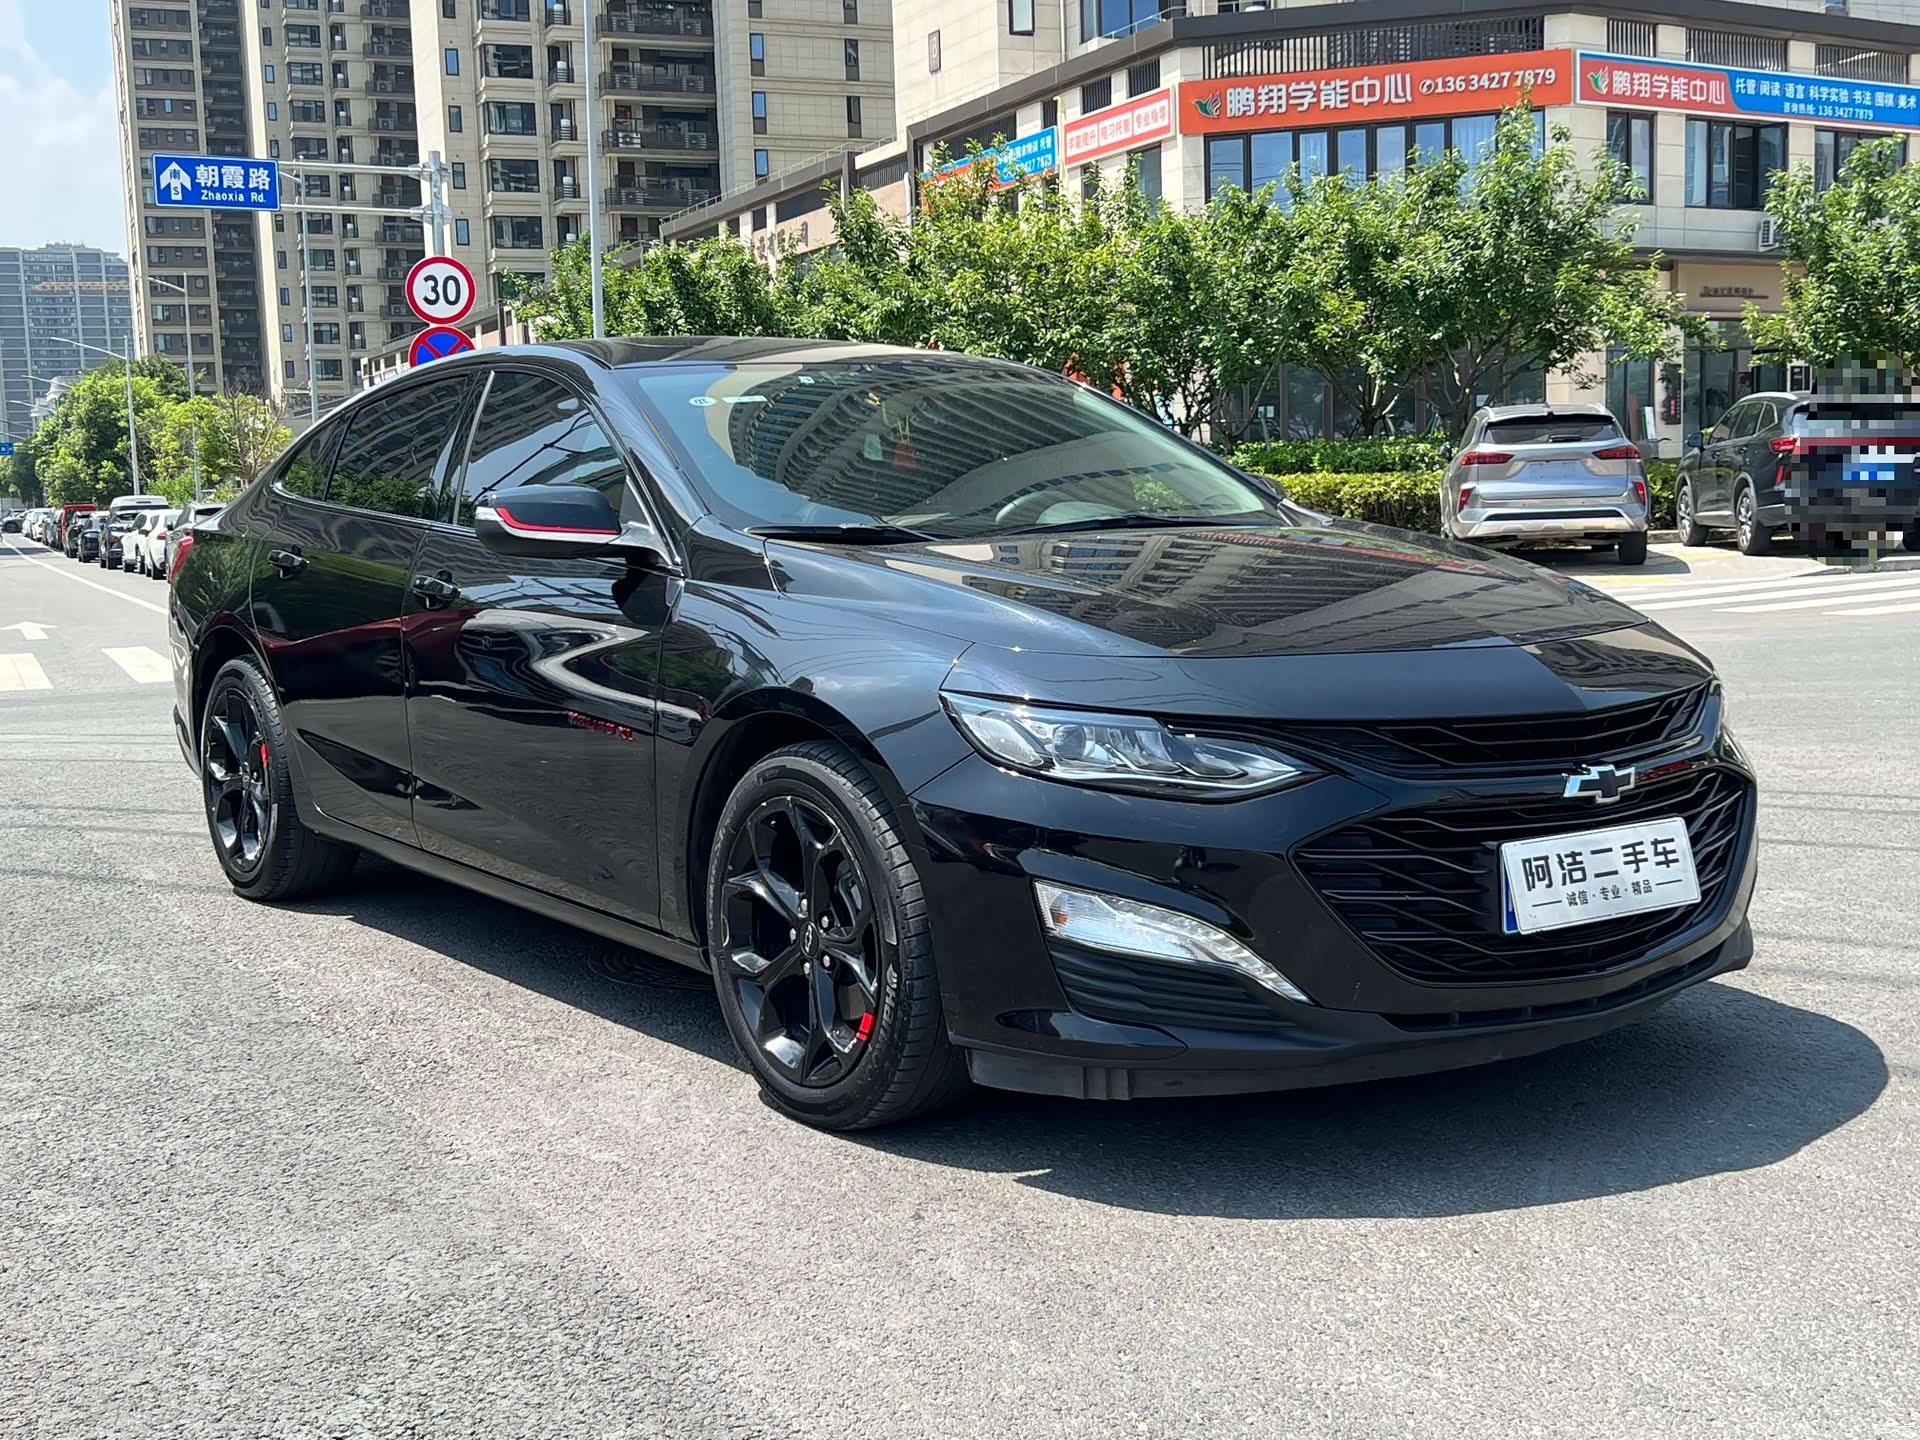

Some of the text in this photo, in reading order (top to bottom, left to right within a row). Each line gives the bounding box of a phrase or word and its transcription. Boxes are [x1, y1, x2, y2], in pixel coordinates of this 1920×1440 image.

[1226, 72, 1413, 118] 鹏翔学能中心
[1434, 67, 1556, 94] 136 3427 7879
[1612, 69, 1726, 105] 鹏翔学能中心
[1735, 77, 1917, 111] 托管 阅读 语言 科学实验 书法 围棋 美术
[1818, 104, 1833, 117] 136
[1834, 105, 1854, 119] 3427
[1854, 107, 1875, 121] 7879
[172, 186, 180, 195] S
[195, 163, 271, 191] 朝霞路
[200, 189, 245, 202] Zhaoxia
[423, 274, 461, 306] 30
[1521, 838, 1680, 892] 阿洁二手车
